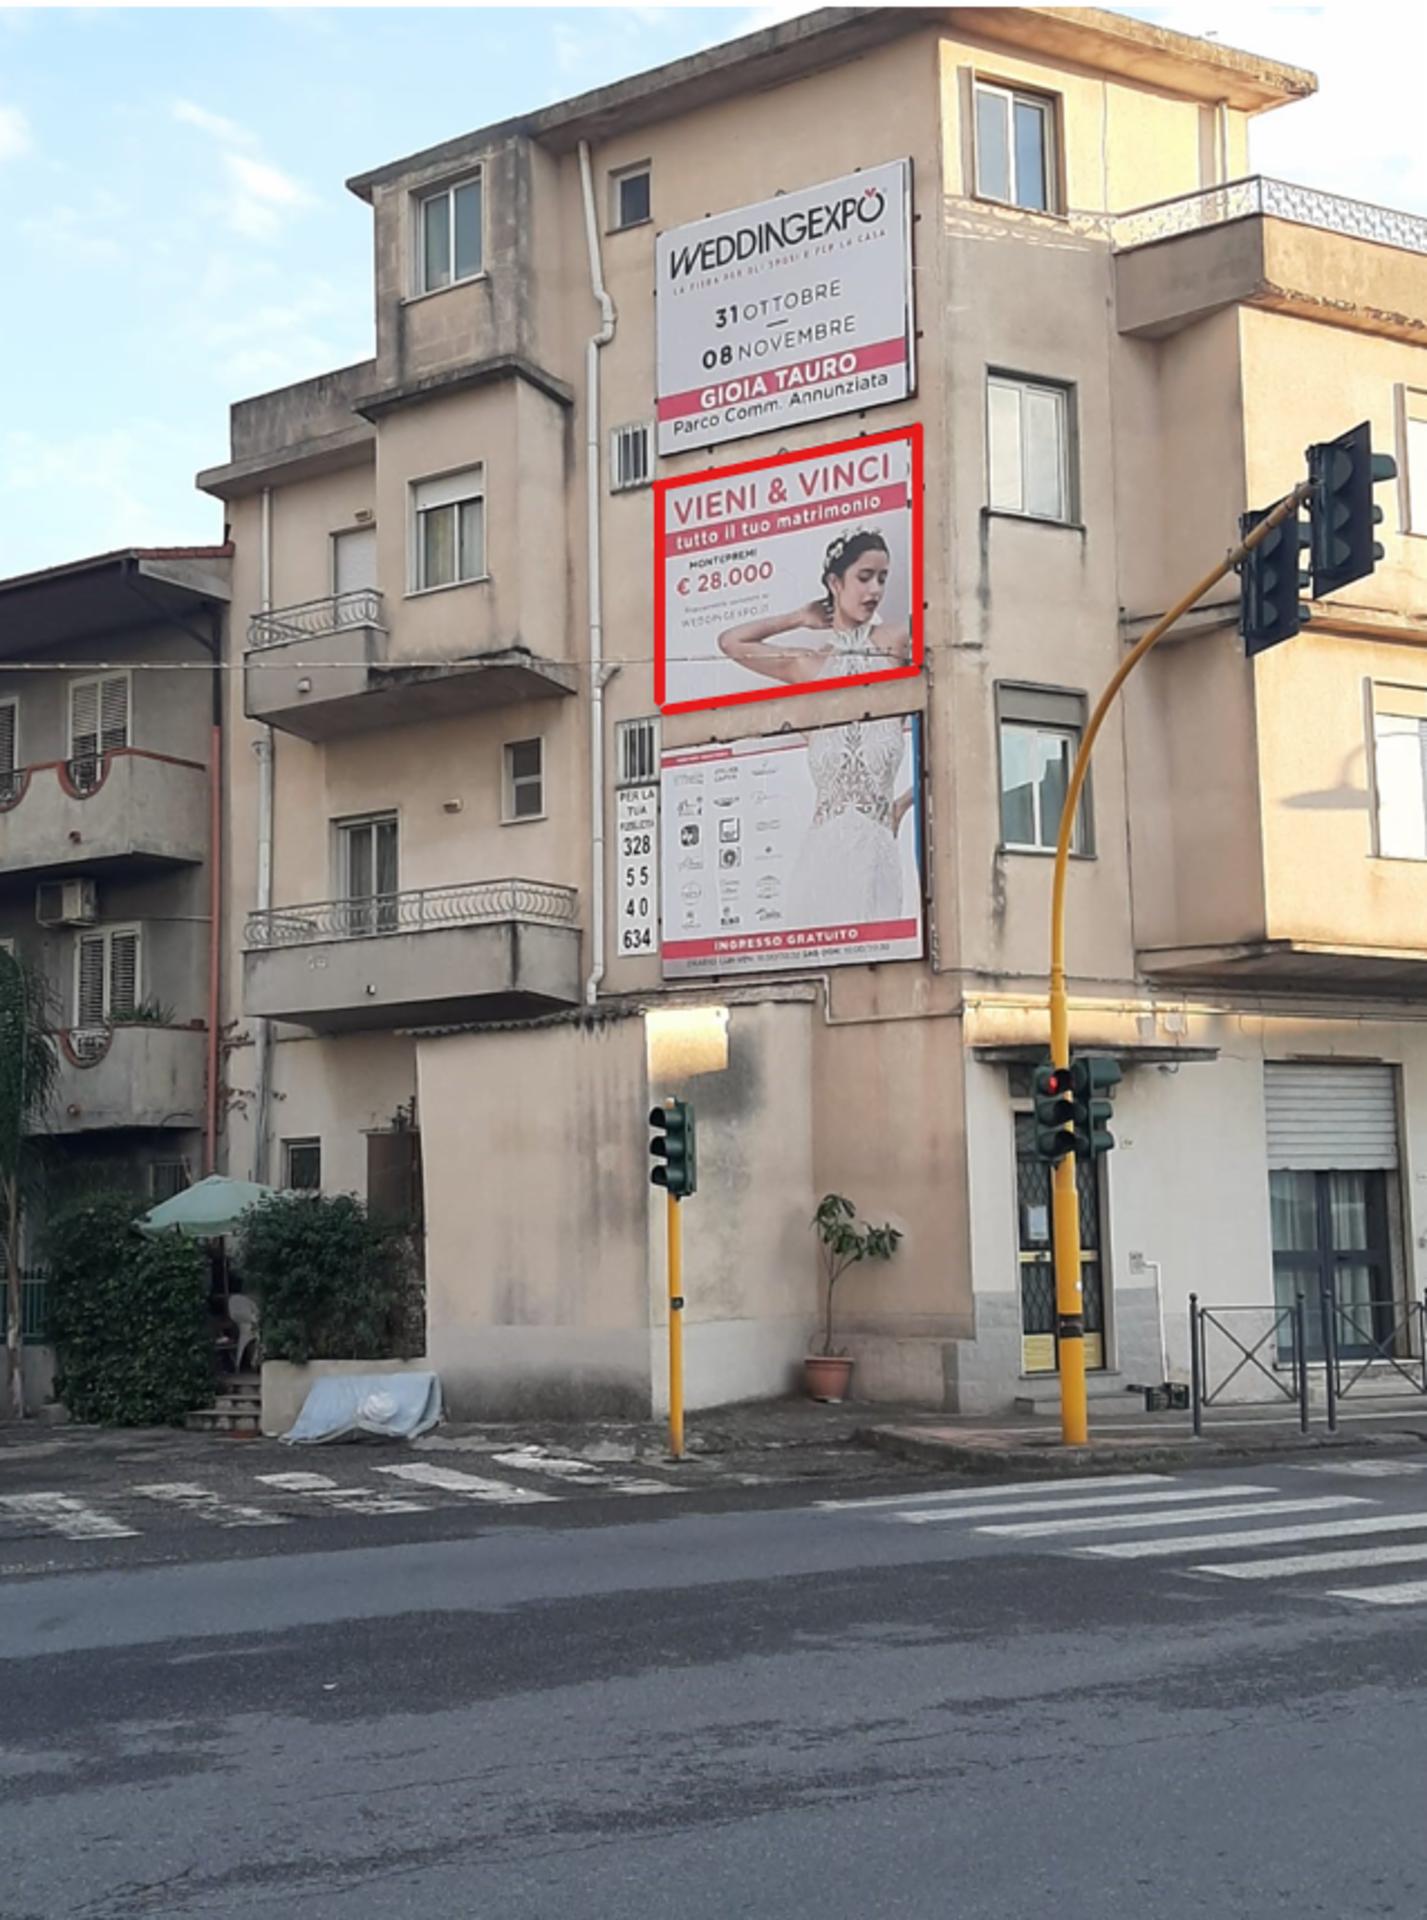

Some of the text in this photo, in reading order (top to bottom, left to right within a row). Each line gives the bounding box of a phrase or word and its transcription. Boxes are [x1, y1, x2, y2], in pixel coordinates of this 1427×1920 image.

[669, 188, 885, 280] WEDDINGEXPO
[715, 279, 842, 329] 31 OTTOBRE
[702, 315, 857, 370] 08 NOVEMBRE
[700, 353, 857, 409] GIOIA TAURO
[673, 372, 888, 437] Parco Comm. Annunziata
[674, 452, 889, 525] VIENI & VINCI
[676, 497, 882, 551] tutto il tuo matrimonio
[676, 560, 774, 596] € 28.000
[688, 548, 758, 571] MONTEPREMI
[619, 790, 655, 803] PER LA
[626, 805, 648, 817] TUA
[623, 835, 651, 856] 328
[623, 928, 651, 949] 634
[714, 928, 859, 951] INGRESSO GRATUITO
